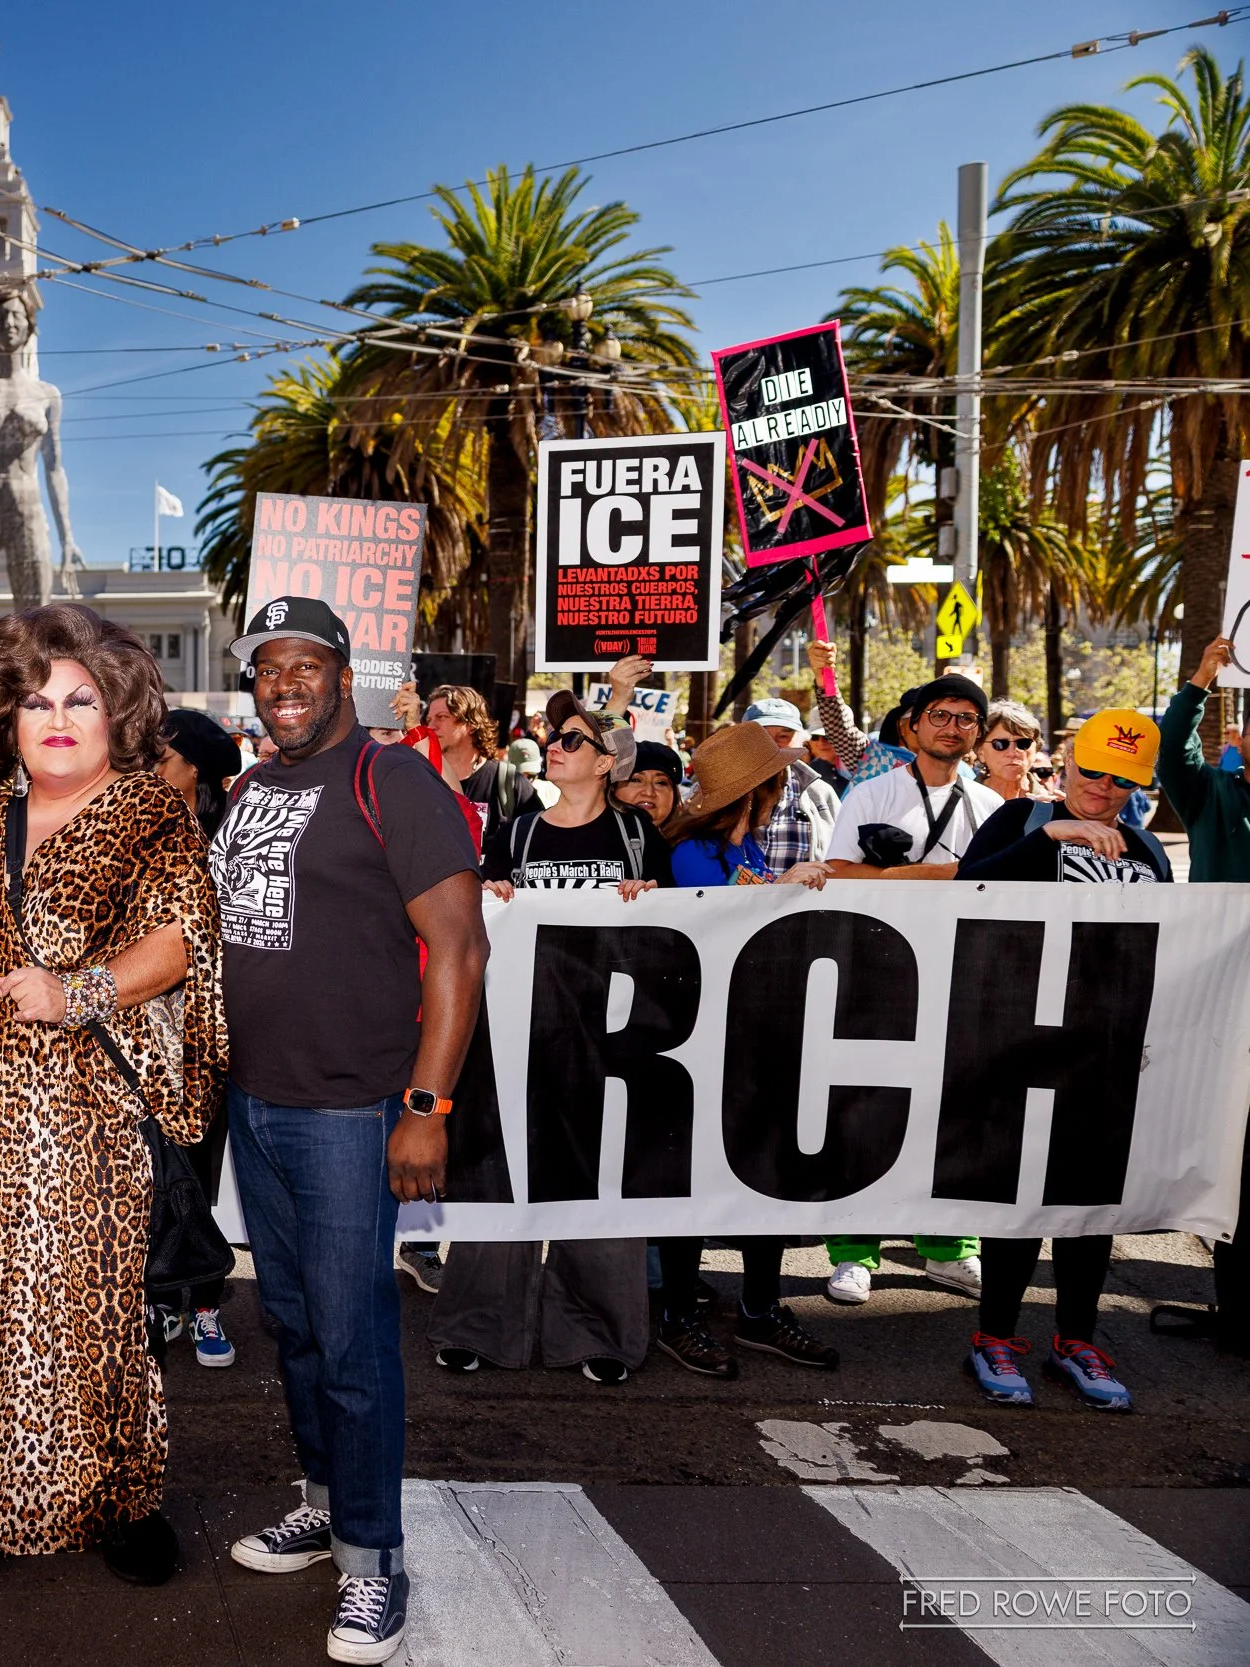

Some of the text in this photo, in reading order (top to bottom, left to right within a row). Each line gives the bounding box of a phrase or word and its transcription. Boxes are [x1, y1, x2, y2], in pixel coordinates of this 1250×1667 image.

[764, 369, 808, 403] DIE
[736, 400, 843, 448] ALREADY
[560, 455, 703, 496] FUERA
[259, 498, 421, 541] NO KINGS
[558, 493, 701, 566] ICE
[257, 534, 419, 568] NO PATRIARCHY
[253, 559, 416, 612] NO ICE
[557, 565, 699, 583] LEVANTADXS POR
[557, 581, 699, 596] NUESTROS CUERPOS,
[557, 594, 699, 611] NUESTRA TIERRA,
[557, 610, 698, 626] NUESTRO FUTURO
[350, 658, 406, 679] BODIES,
[629, 690, 671, 714] ICE
[264, 809, 310, 918] We Are Here
[525, 862, 558, 880] People's
[559, 864, 589, 877] March
[599, 864, 622, 880] Rally
